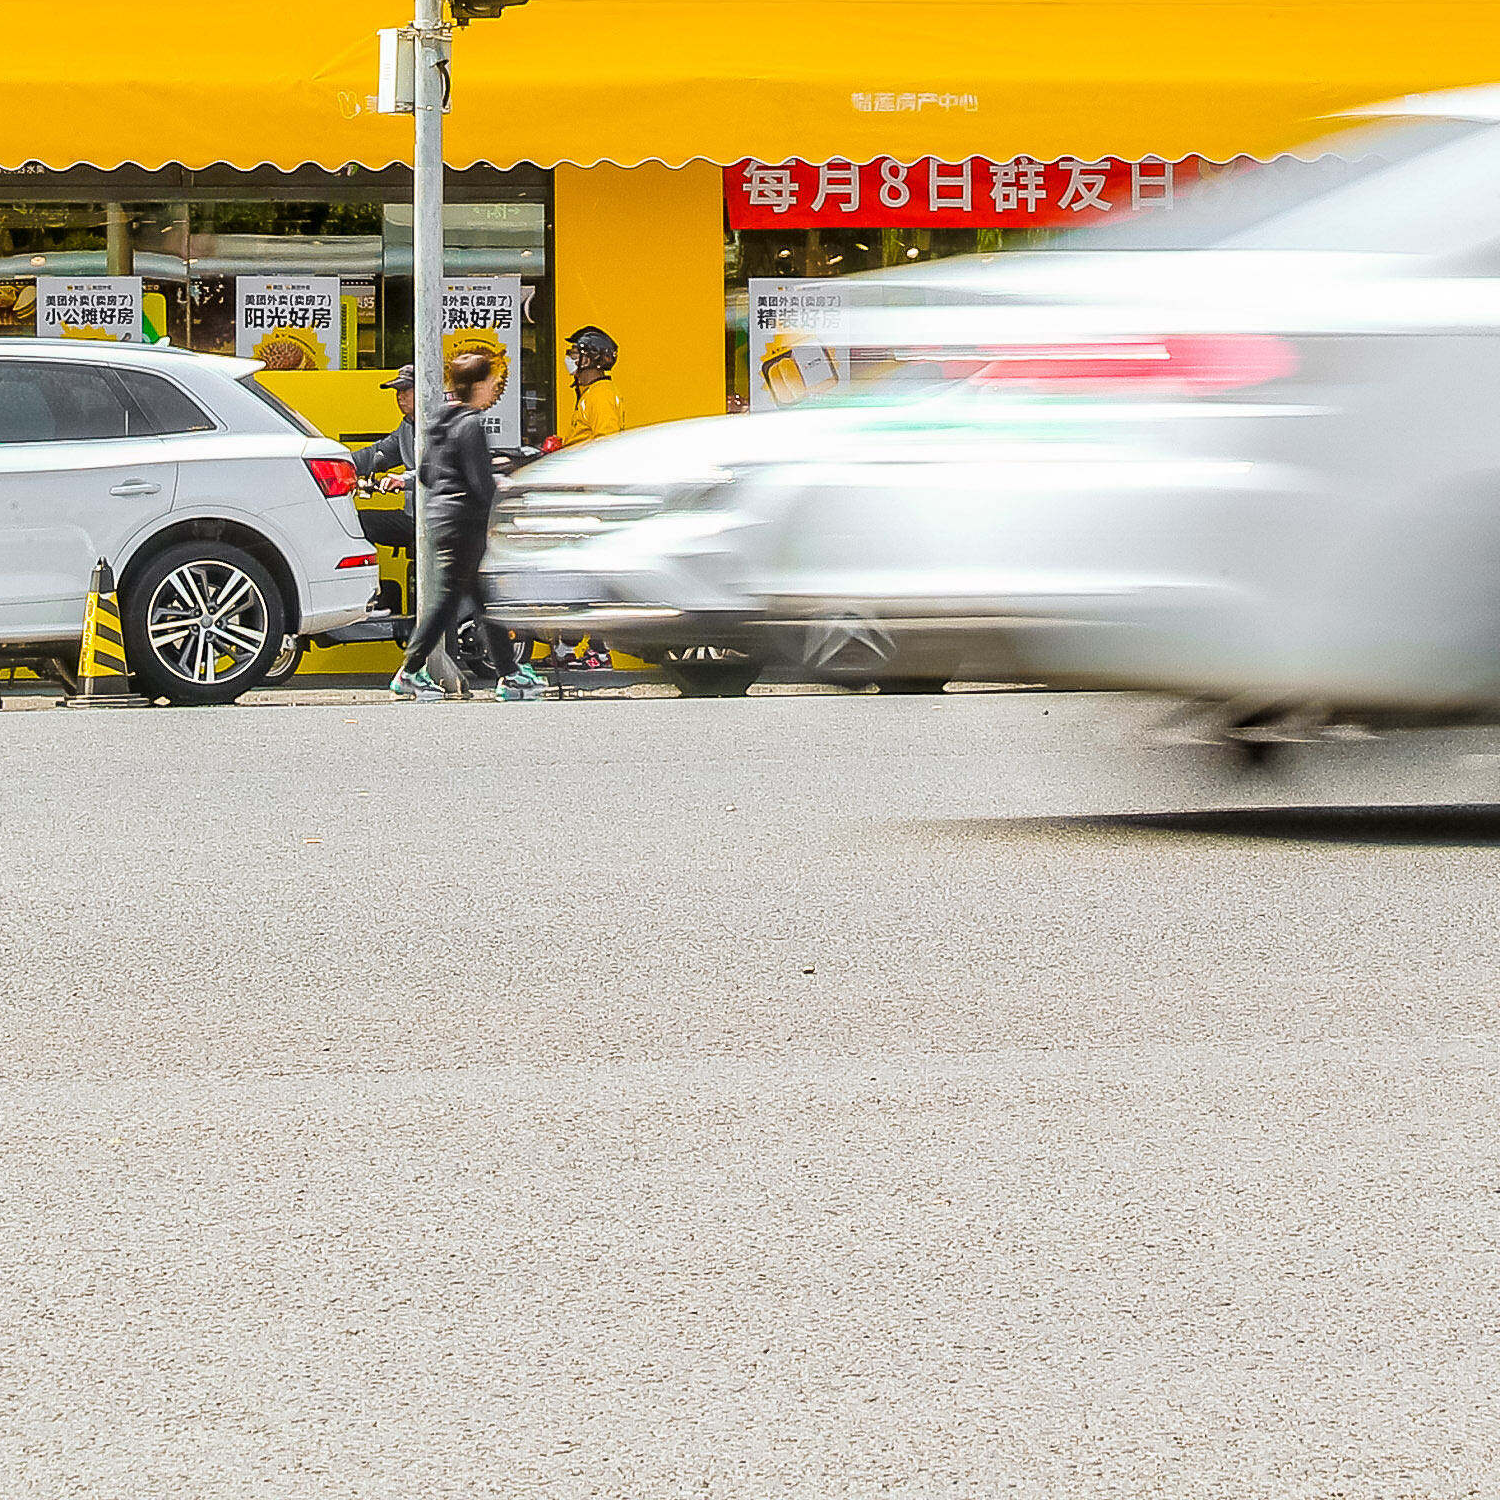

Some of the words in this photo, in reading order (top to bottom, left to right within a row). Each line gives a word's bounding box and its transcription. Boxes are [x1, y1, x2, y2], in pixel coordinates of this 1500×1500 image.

[742, 156, 1175, 213] 每月8日群友日
[45, 293, 134, 307] 美团外卖(卖房了)
[244, 293, 332, 307] 美团外卖(卖房了)
[44, 306, 135, 326] 小公摊好房
[244, 306, 332, 329] 阳光好房
